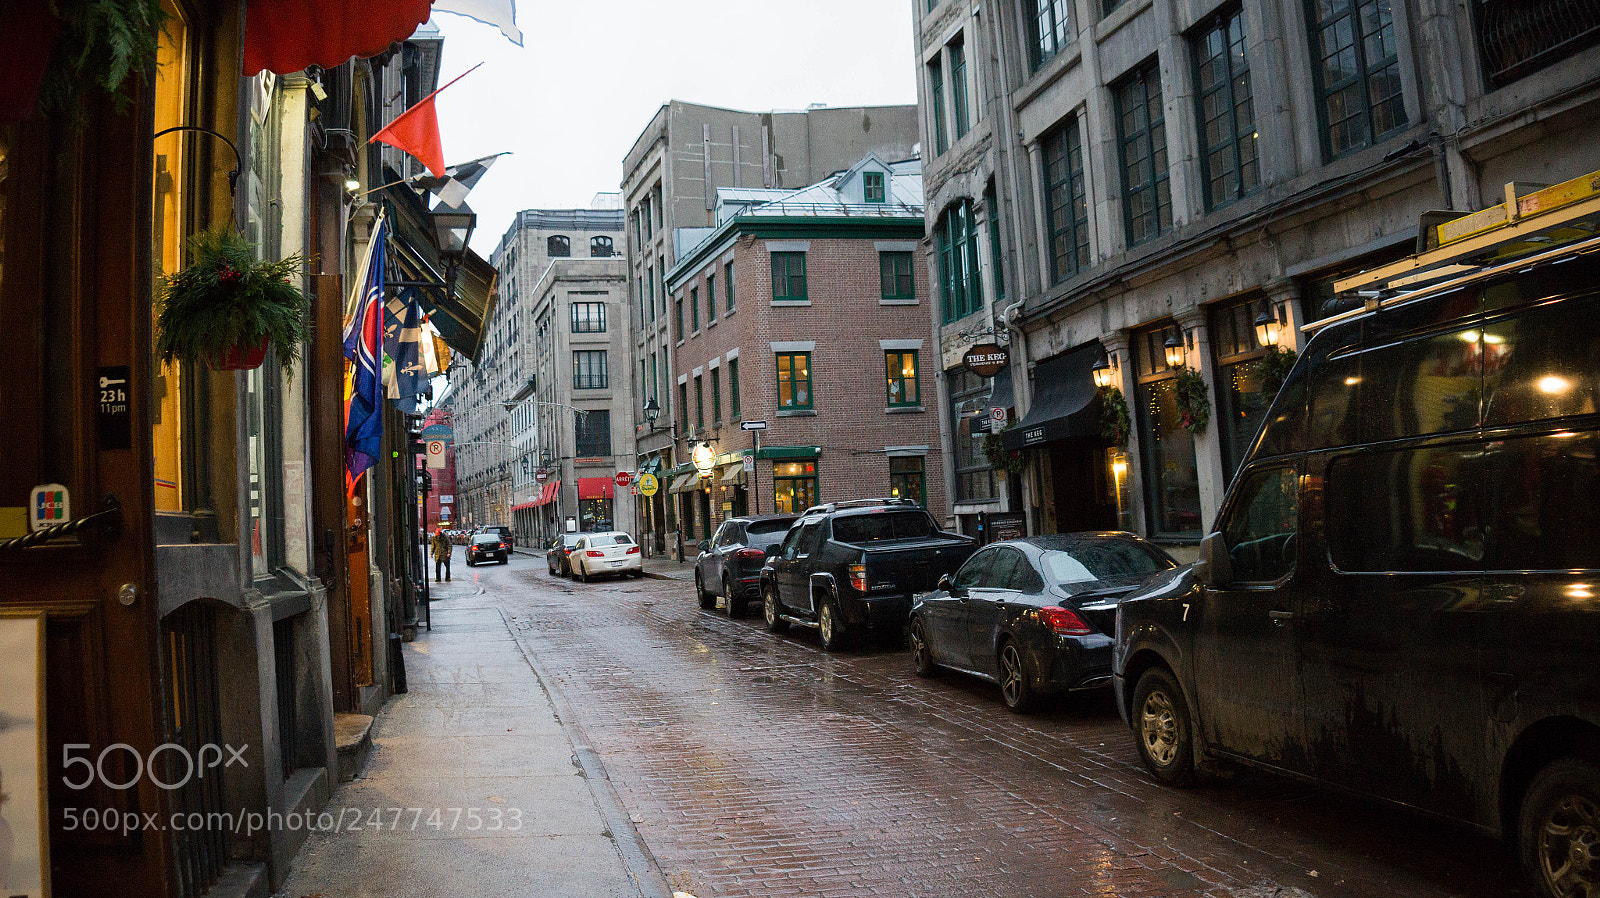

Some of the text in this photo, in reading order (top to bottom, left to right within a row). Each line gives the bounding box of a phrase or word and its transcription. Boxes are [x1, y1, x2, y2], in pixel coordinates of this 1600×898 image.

[967, 352, 1006, 362] THE KEG
[100, 388, 126, 402] 23 h
[1025, 431, 1034, 439] THE
[1182, 603, 1190, 622] 7
